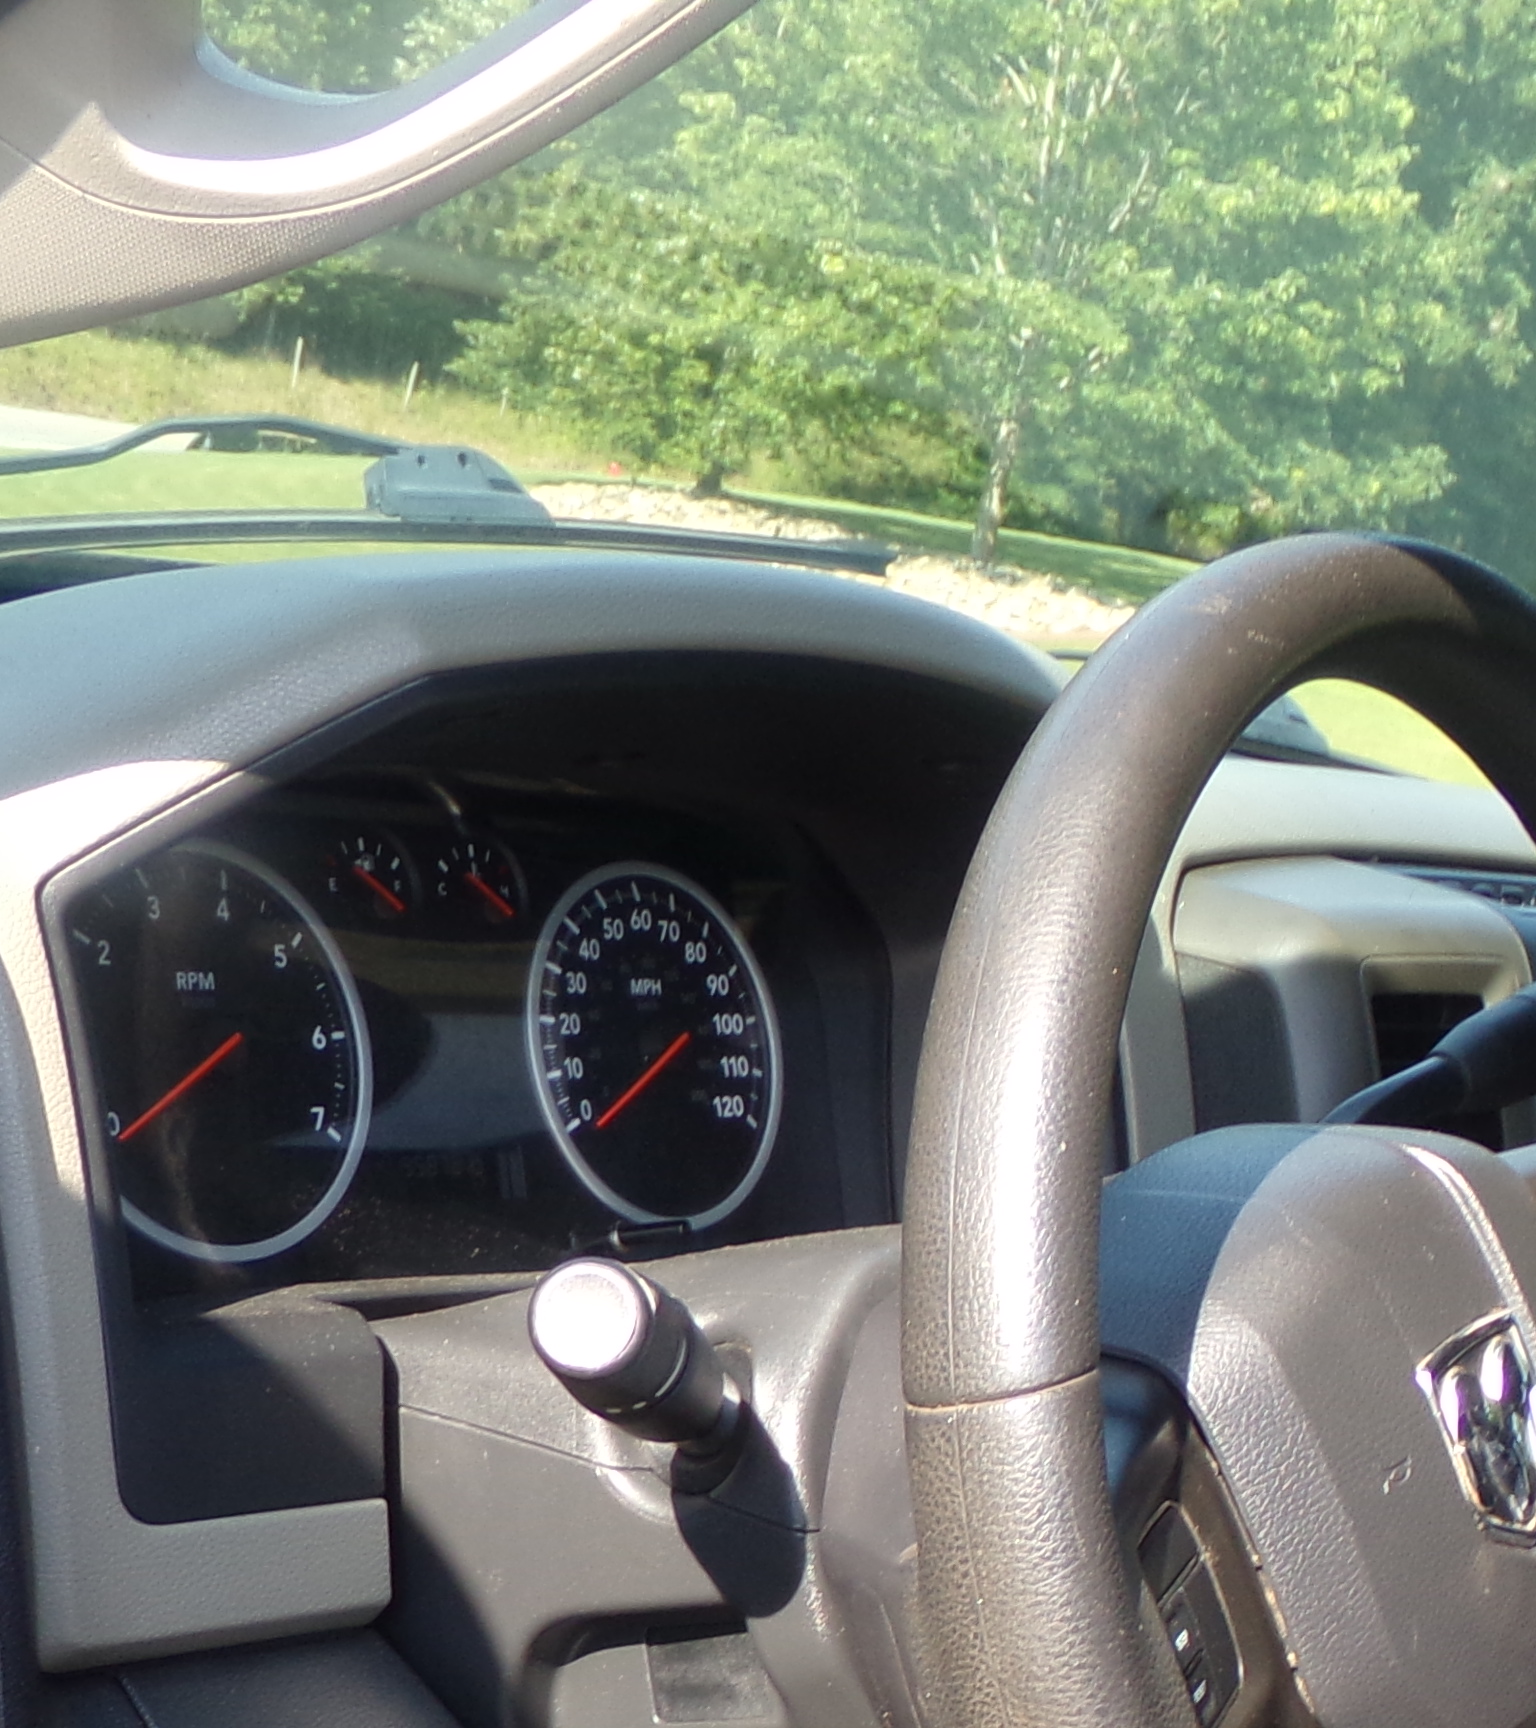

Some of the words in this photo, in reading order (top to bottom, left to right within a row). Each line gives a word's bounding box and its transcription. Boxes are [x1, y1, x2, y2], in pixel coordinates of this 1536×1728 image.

[438, 883, 447, 896] C
[147, 896, 160, 919] 3
[217, 898, 230, 921] 4
[603, 918, 624, 940] 50
[630, 909, 652, 931] 60
[657, 920, 680, 942] 70
[97, 940, 111, 965] 2
[274, 944, 287, 968] 5
[579, 938, 600, 960] 40
[685, 941, 707, 964] 80
[176, 971, 215, 990] RPM
[566, 972, 587, 994] 30
[630, 978, 662, 995] MPH
[706, 974, 729, 996] 90
[559, 1013, 581, 1035] 20
[713, 1013, 744, 1035] 100
[312, 1025, 327, 1049] 6
[564, 1057, 584, 1079] 10
[720, 1056, 749, 1077] 110
[580, 1099, 592, 1121] 0
[713, 1095, 745, 1117] 120
[310, 1106, 325, 1131] 7
